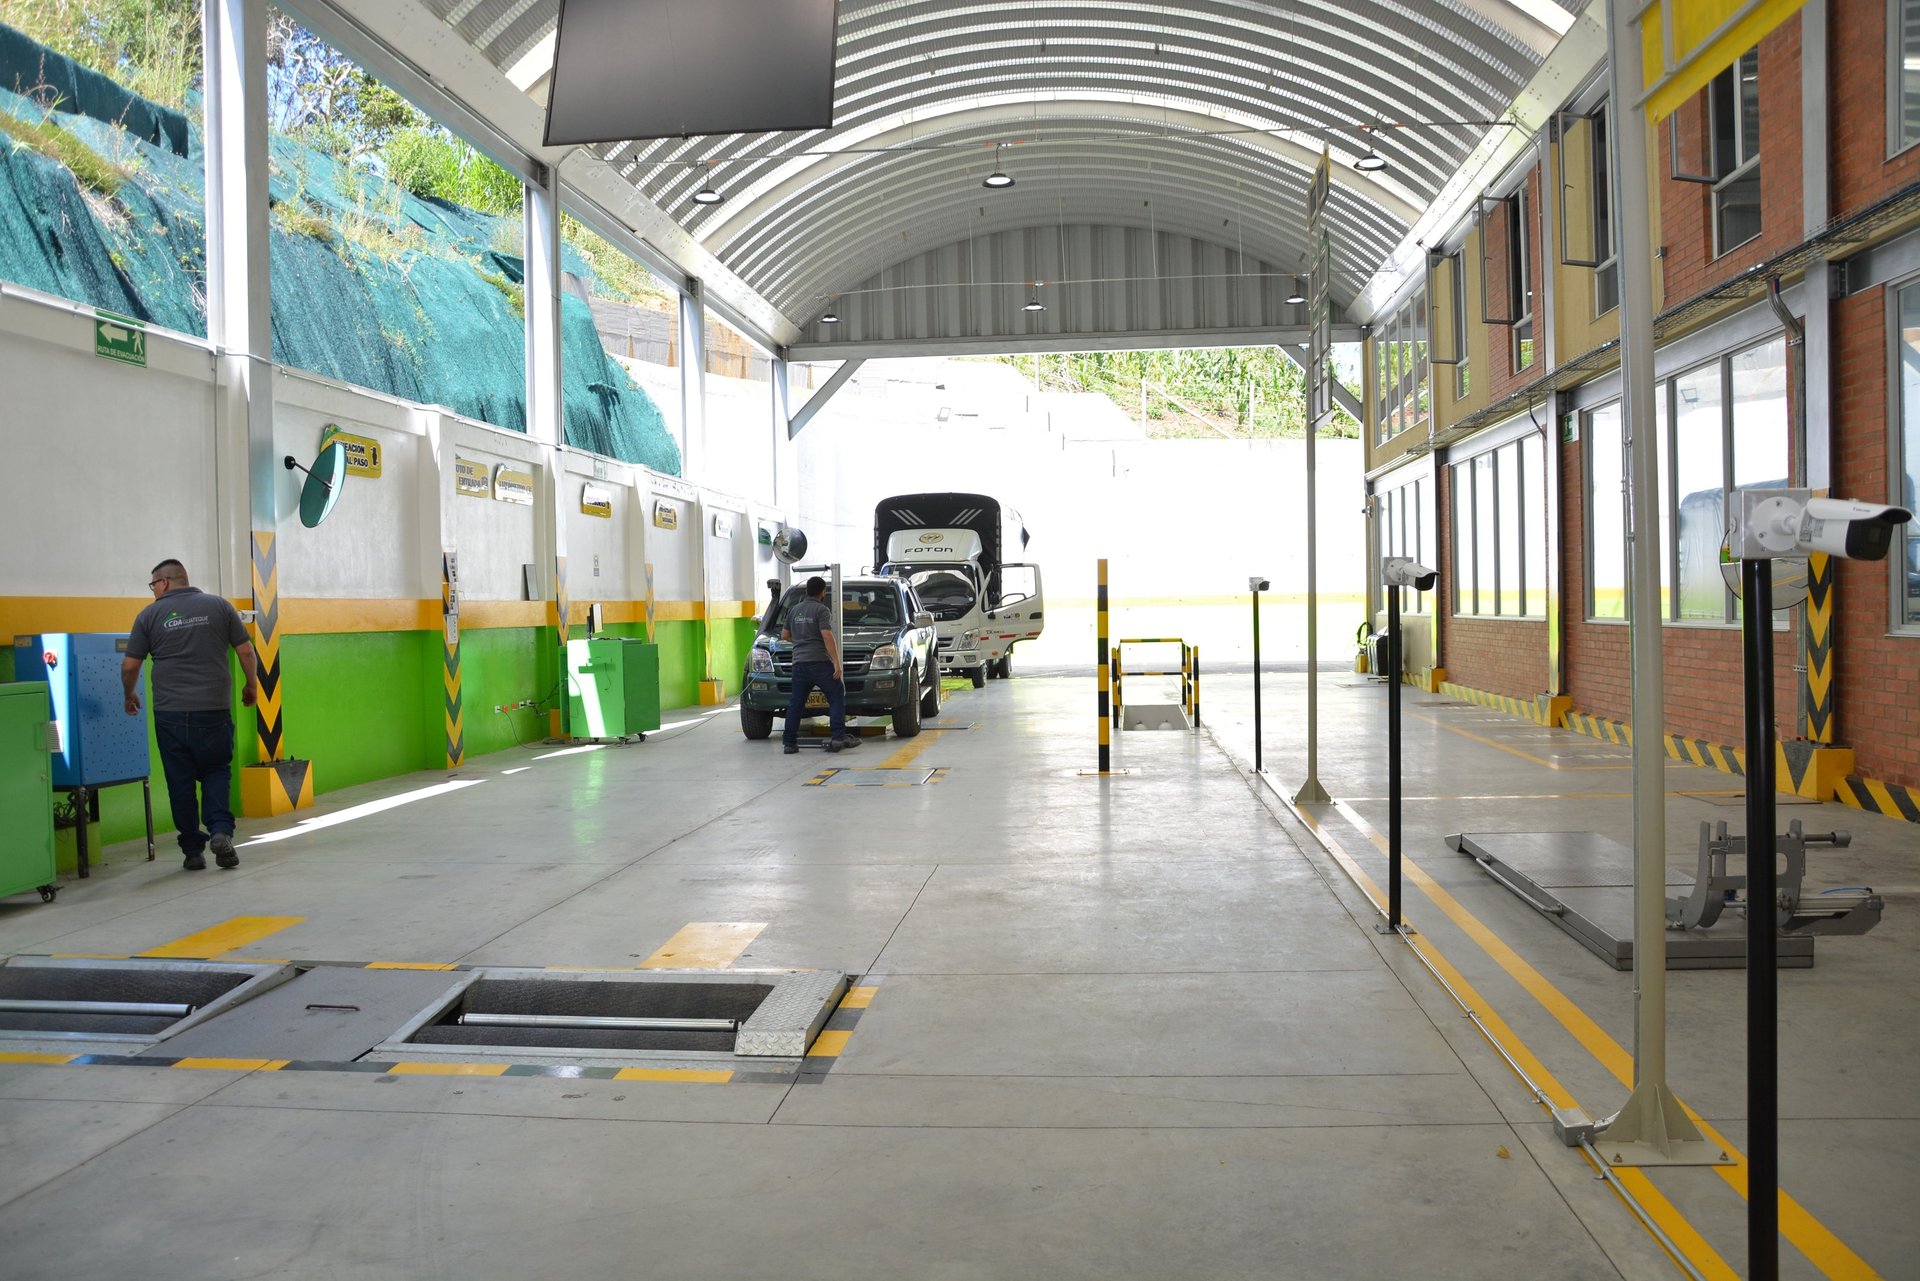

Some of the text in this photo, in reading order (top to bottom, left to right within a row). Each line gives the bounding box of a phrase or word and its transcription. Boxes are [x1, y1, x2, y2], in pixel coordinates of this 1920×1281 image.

[97, 345, 109, 354] RUTA
[110, 348, 117, 357] DE
[353, 457, 369, 467] PASO
[466, 466, 474, 476] DE
[458, 476, 481, 488] ENTRADA
[168, 619, 183, 628] CDA
